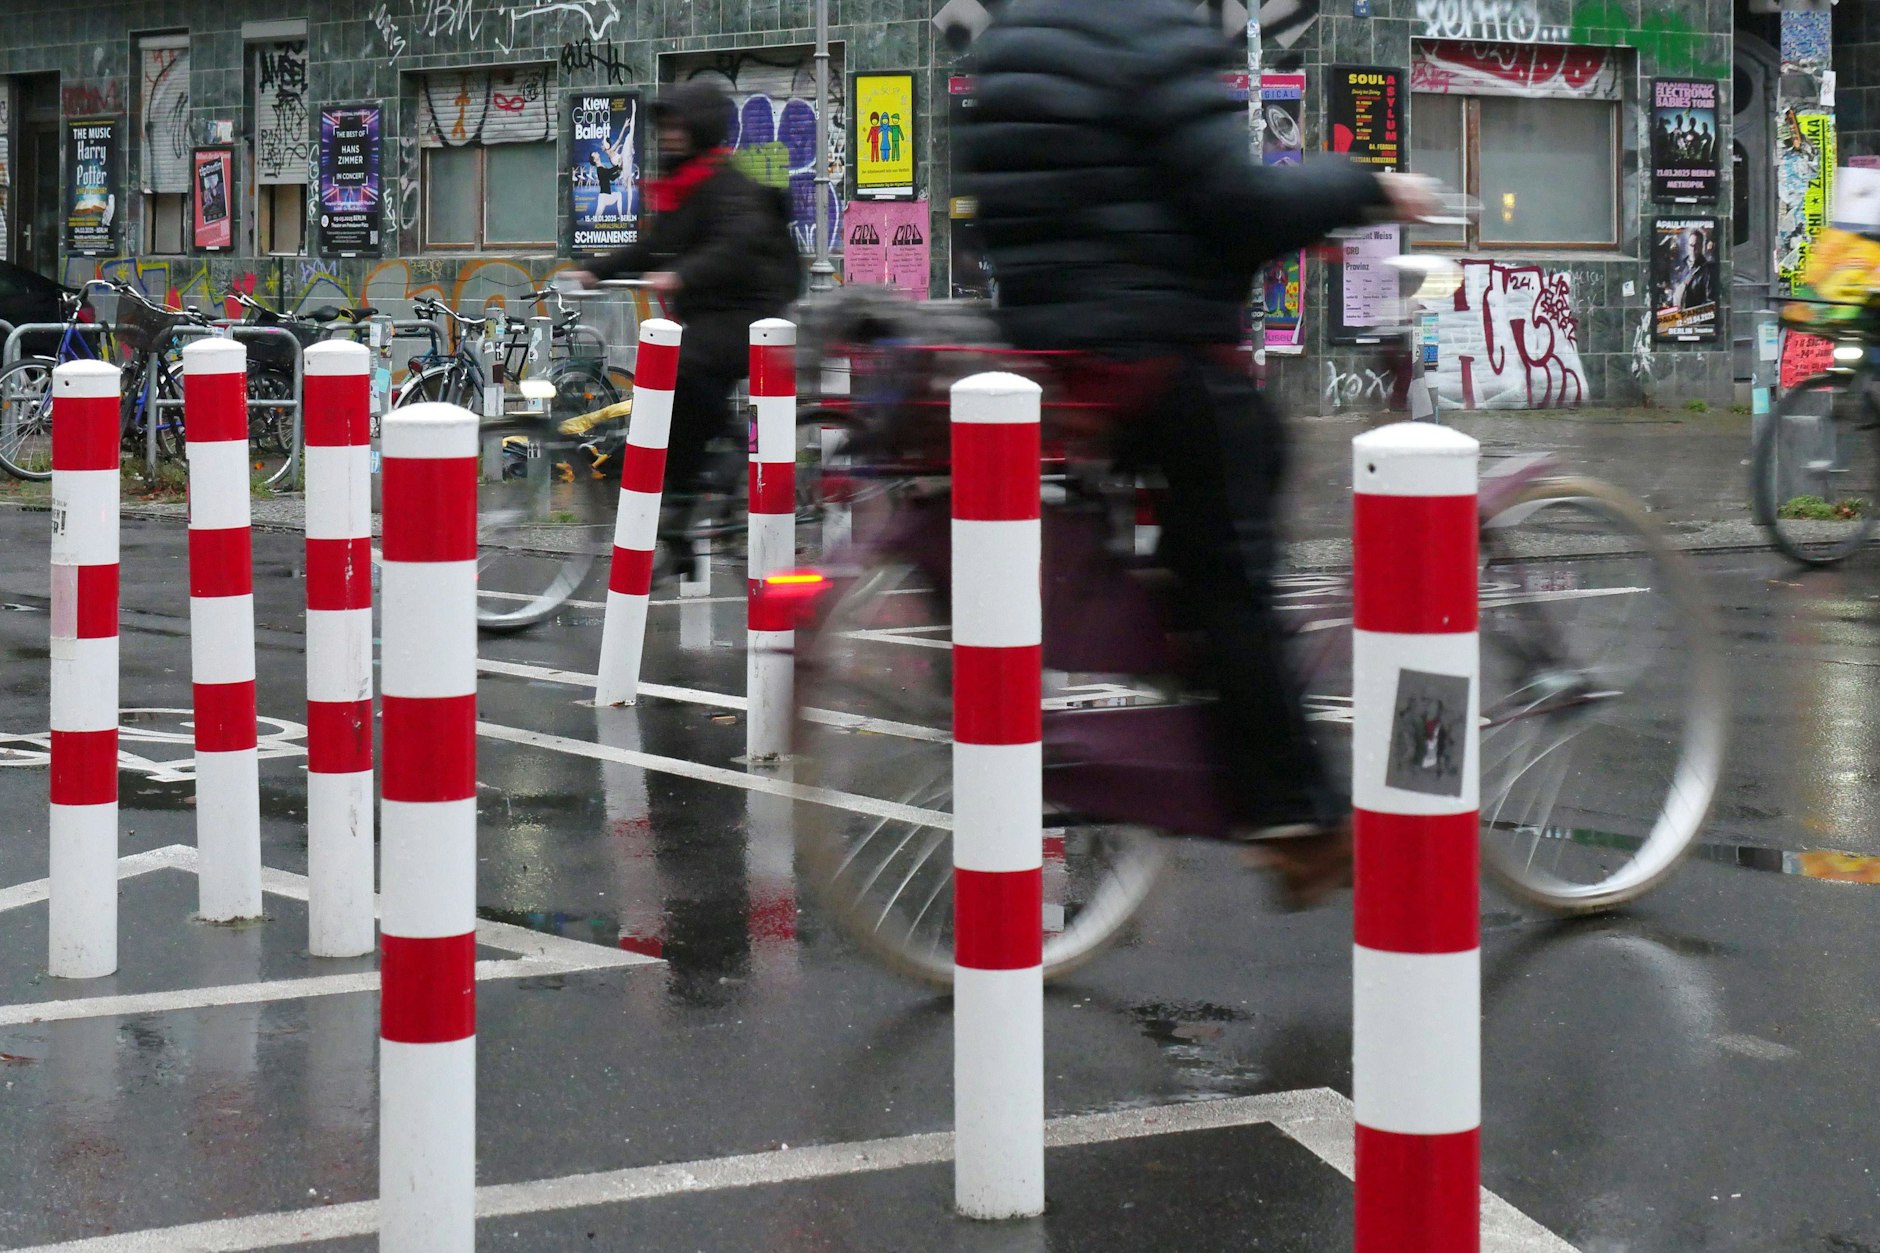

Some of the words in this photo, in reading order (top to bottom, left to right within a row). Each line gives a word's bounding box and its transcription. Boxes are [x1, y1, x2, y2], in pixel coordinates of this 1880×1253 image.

[1348, 73, 1386, 85] SOUL
[1656, 87, 1715, 99] ELECTRONIC
[582, 97, 610, 111] Kiew
[1385, 74, 1398, 141] ASYLUM
[1656, 97, 1691, 108] BABIES
[1692, 99, 1715, 108] TOUR
[572, 107, 611, 125] Grand
[73, 128, 87, 140] THE
[88, 127, 112, 139] MUSIC
[359, 130, 366, 138] OF
[575, 123, 611, 140] Ballett
[77, 140, 107, 165] Harry
[341, 145, 360, 154] HANS
[337, 156, 364, 165] ZIMMER
[76, 164, 108, 186] Potter
[1691, 169, 1716, 177] BERLIN
[1666, 180, 1705, 189] METROPOL
[620, 214, 637, 222] BERLIN
[574, 230, 638, 244] SCHWANENSEE
[1373, 231, 1393, 240] Weiss
[1345, 246, 1360, 256] CRO
[1345, 262, 1370, 271] Provinz
[1509, 275, 1535, 290] 24.
[1668, 327, 1693, 335] BERLIN
